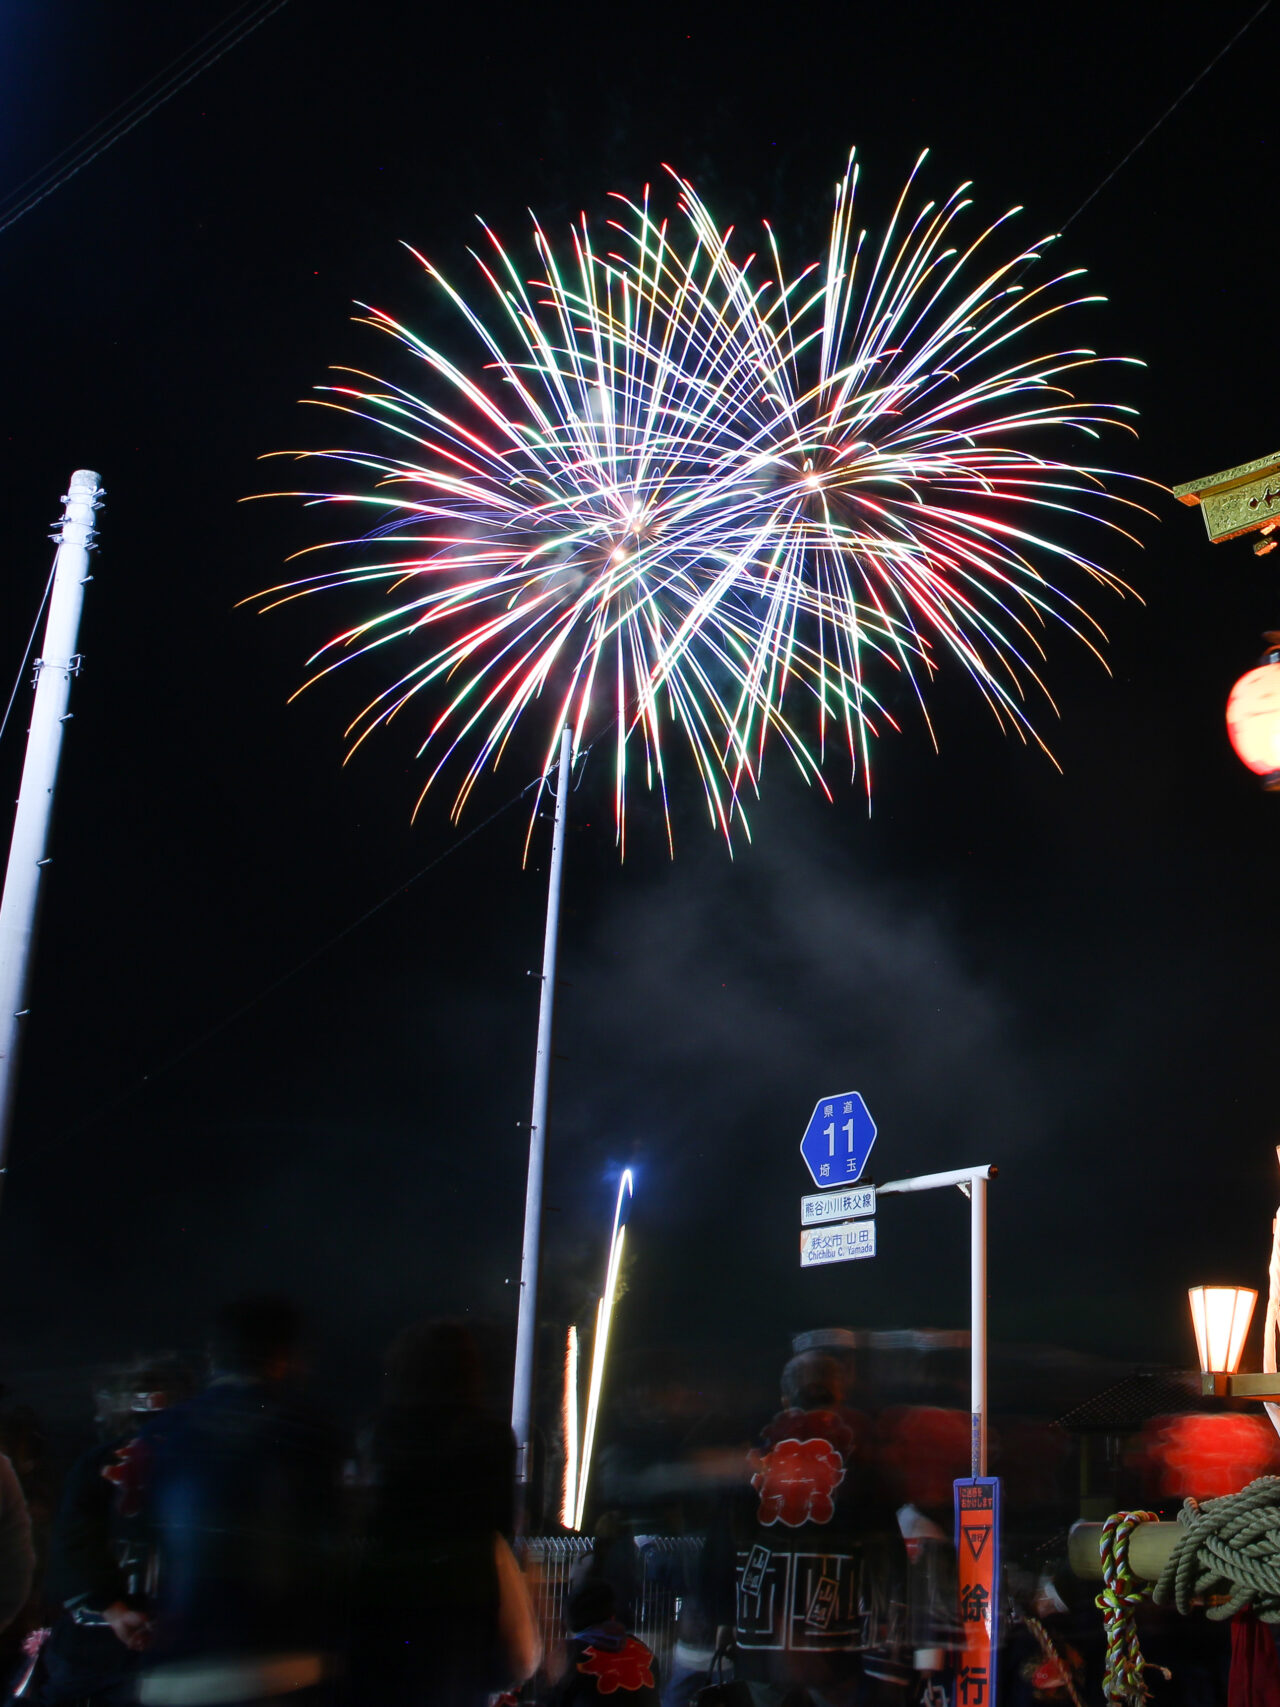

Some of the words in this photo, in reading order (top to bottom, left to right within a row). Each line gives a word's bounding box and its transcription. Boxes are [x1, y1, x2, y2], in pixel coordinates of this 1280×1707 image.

[823, 1101, 853, 1118] 県道
[823, 1118, 854, 1157] 11
[819, 1158, 857, 1177] 埼玉
[805, 1193, 872, 1217] 熊谷小川秩父線
[808, 1248, 836, 1262] Chichibu
[848, 1243, 873, 1256] Yamada
[960, 1583, 989, 1705] 徐行
